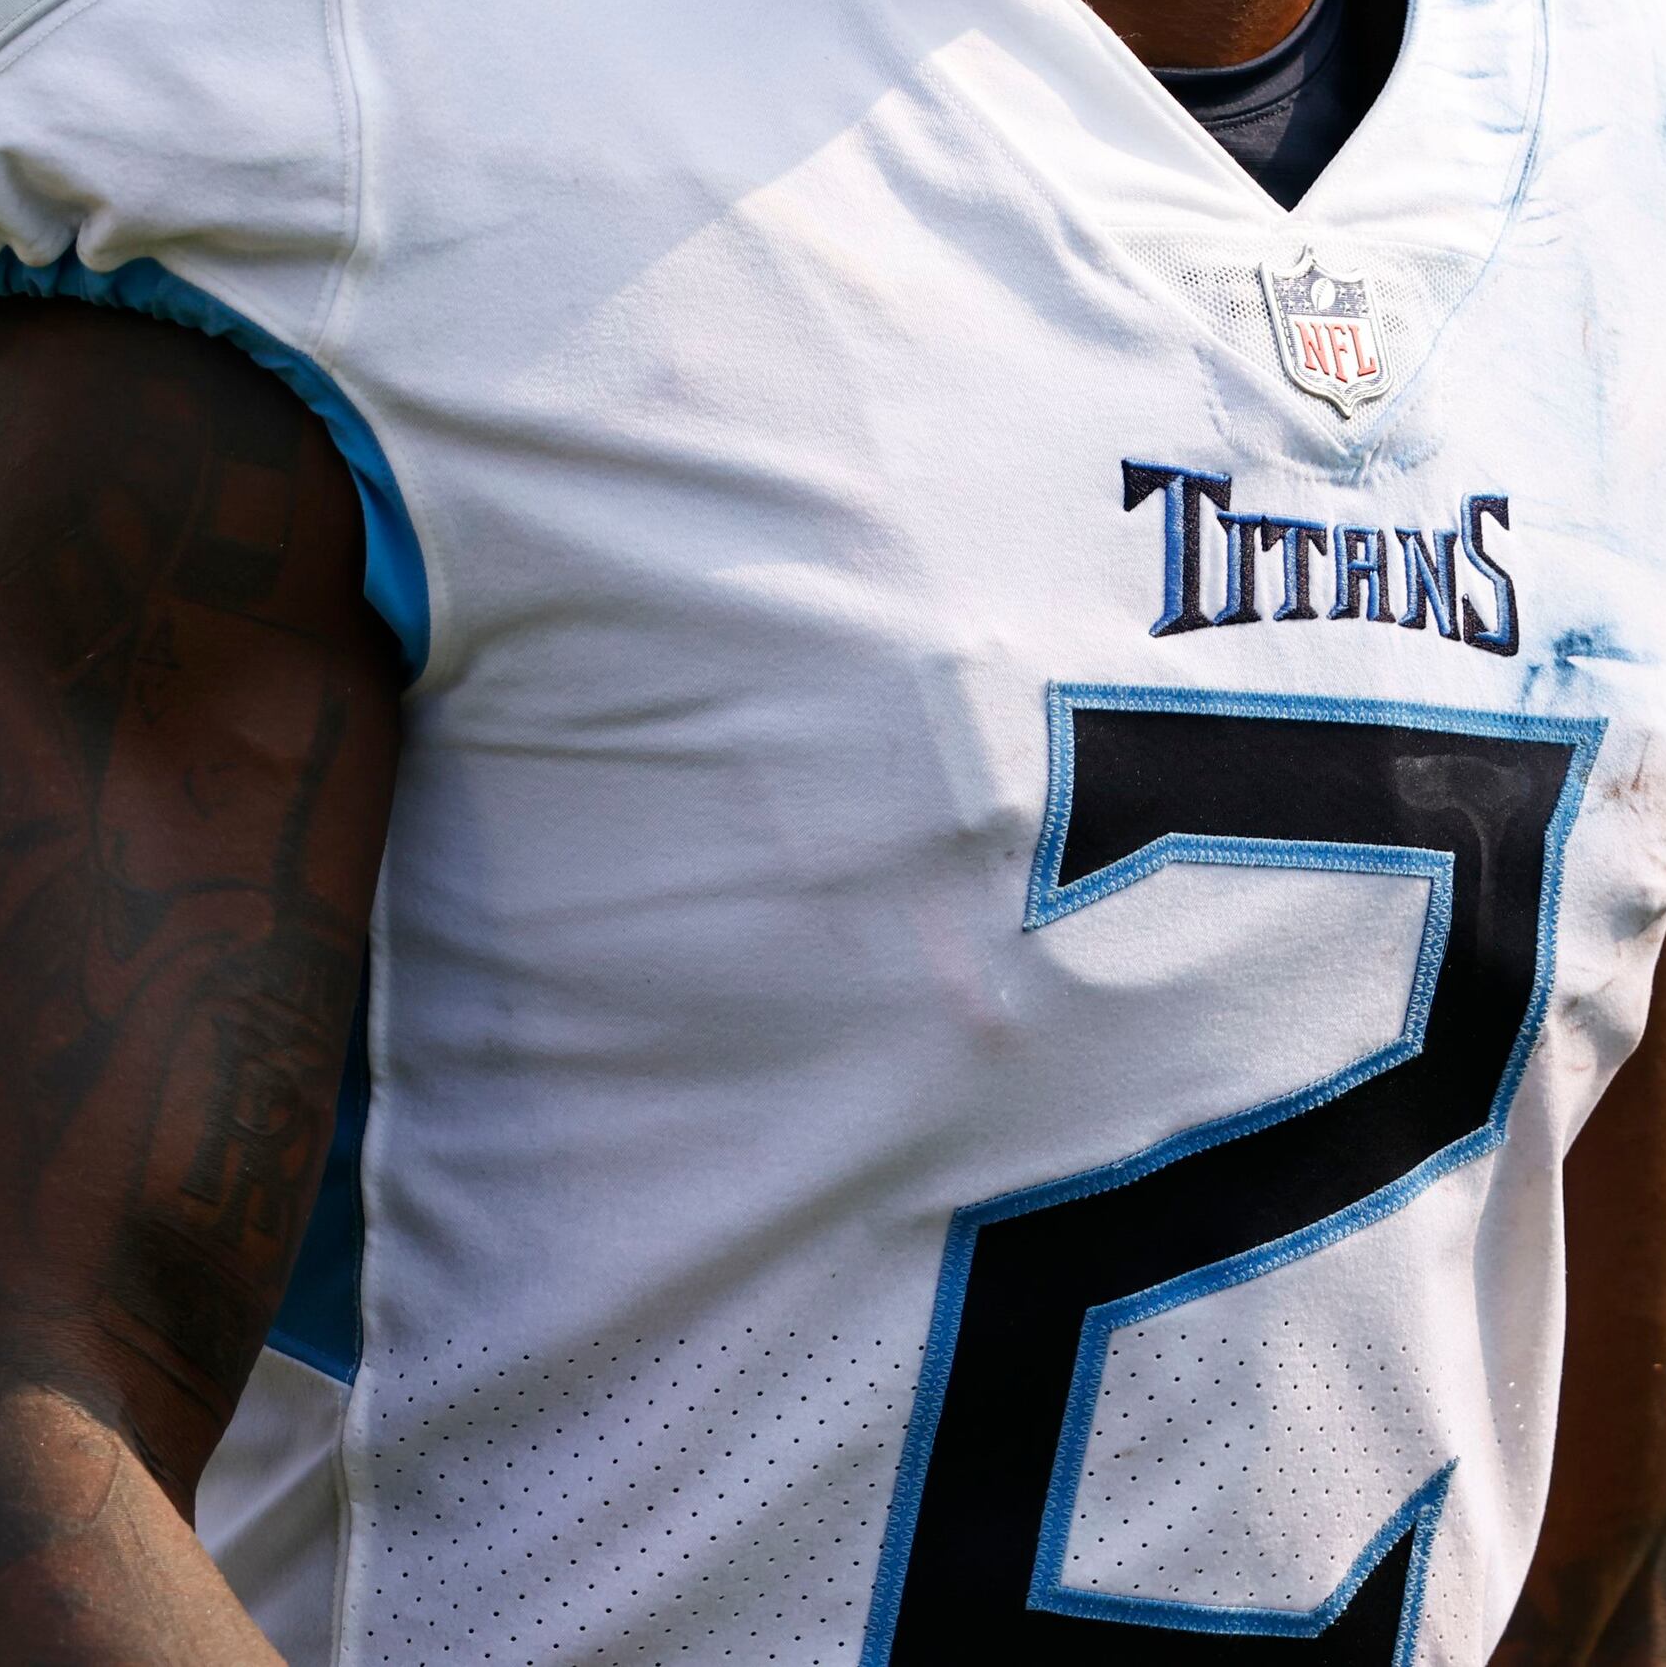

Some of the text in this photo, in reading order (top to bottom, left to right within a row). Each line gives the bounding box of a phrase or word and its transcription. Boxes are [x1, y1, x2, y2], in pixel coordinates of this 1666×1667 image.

[1295, 321, 1376, 382] NFL
[1122, 458, 1519, 656] TITANS
[859, 680, 1608, 1667] 2
